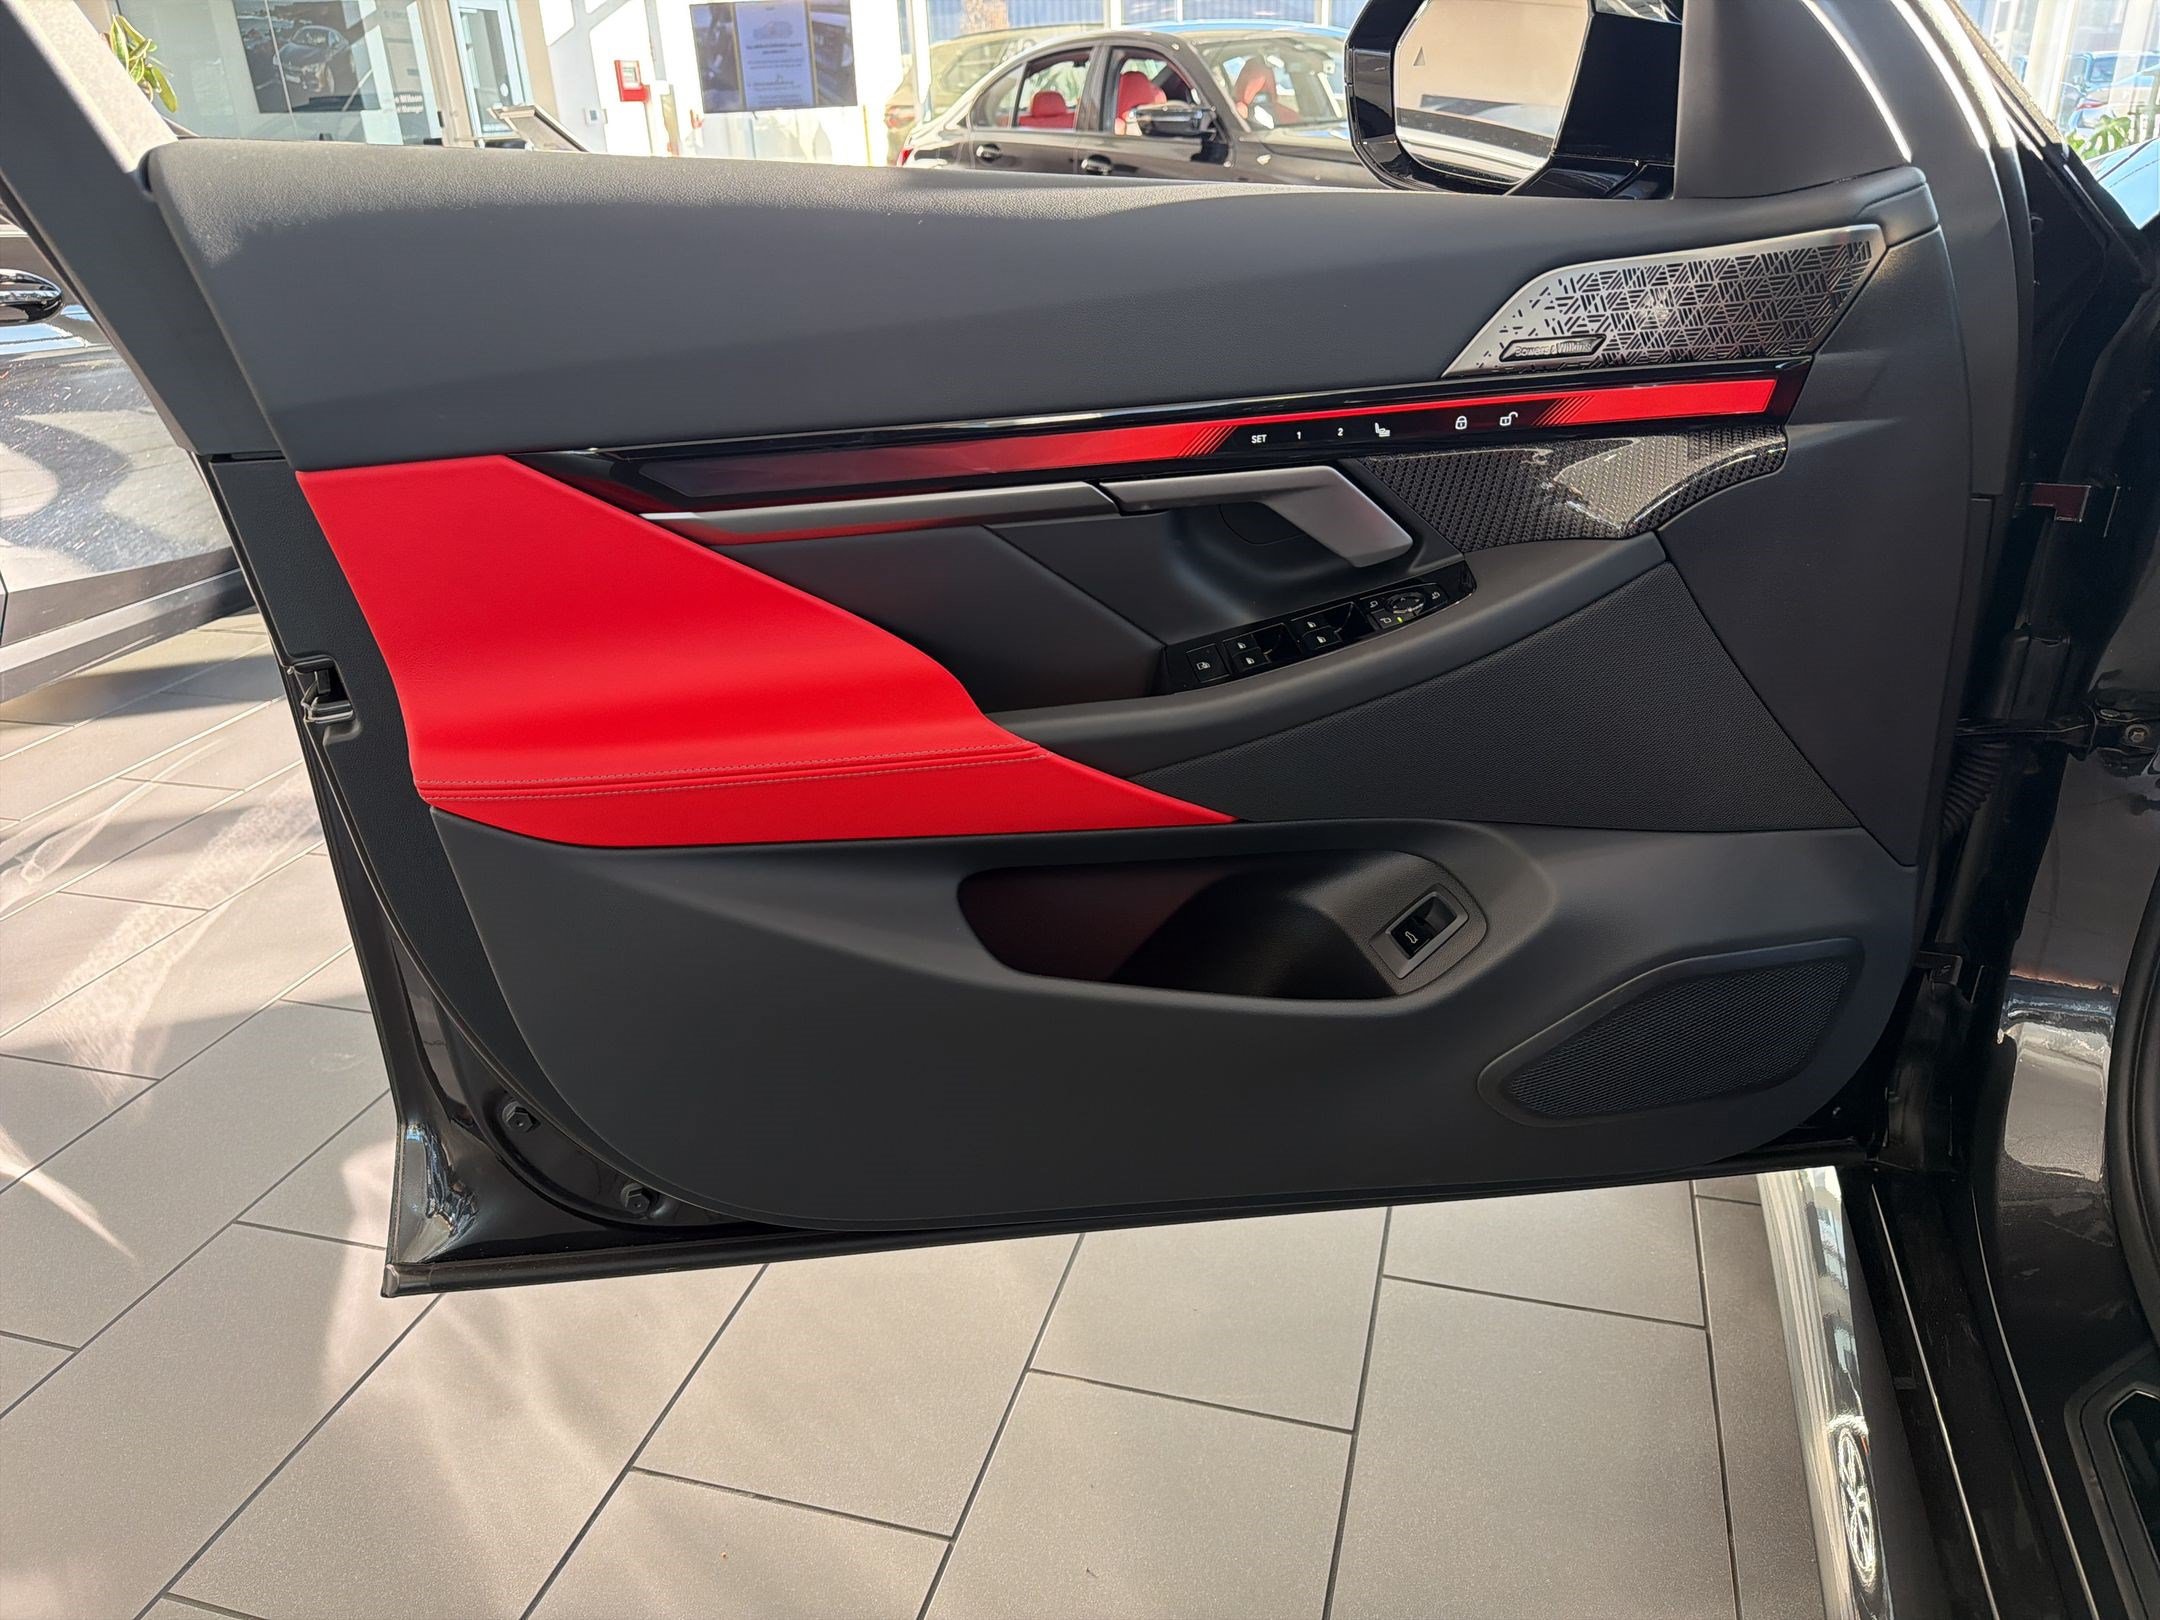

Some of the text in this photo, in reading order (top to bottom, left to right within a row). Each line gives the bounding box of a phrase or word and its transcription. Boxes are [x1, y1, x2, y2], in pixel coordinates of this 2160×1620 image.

[1514, 345, 1550, 357] Bowers
[1557, 342, 1592, 354] Wilkins
[1251, 427, 1344, 444] SET 1 2
